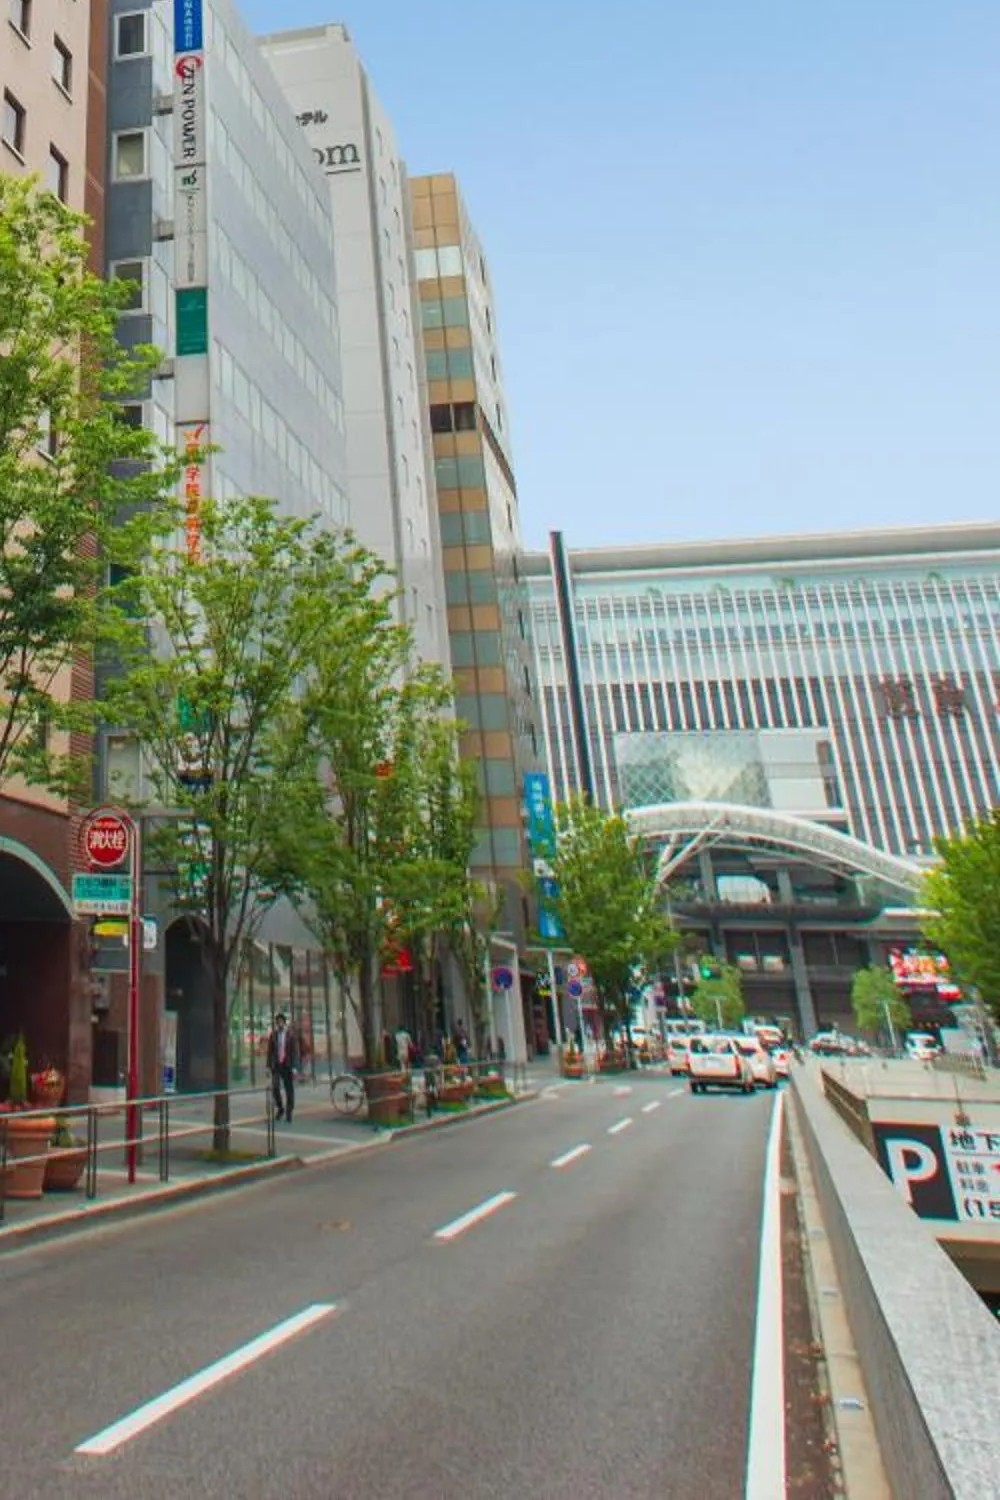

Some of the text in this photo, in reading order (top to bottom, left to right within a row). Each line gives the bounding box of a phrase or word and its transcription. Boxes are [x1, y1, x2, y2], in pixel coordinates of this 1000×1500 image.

[182, 64, 195, 94] ZEN
[181, 99, 196, 157] POWER
[89, 829, 124, 849] 消火栓
[884, 1138, 938, 1204] P
